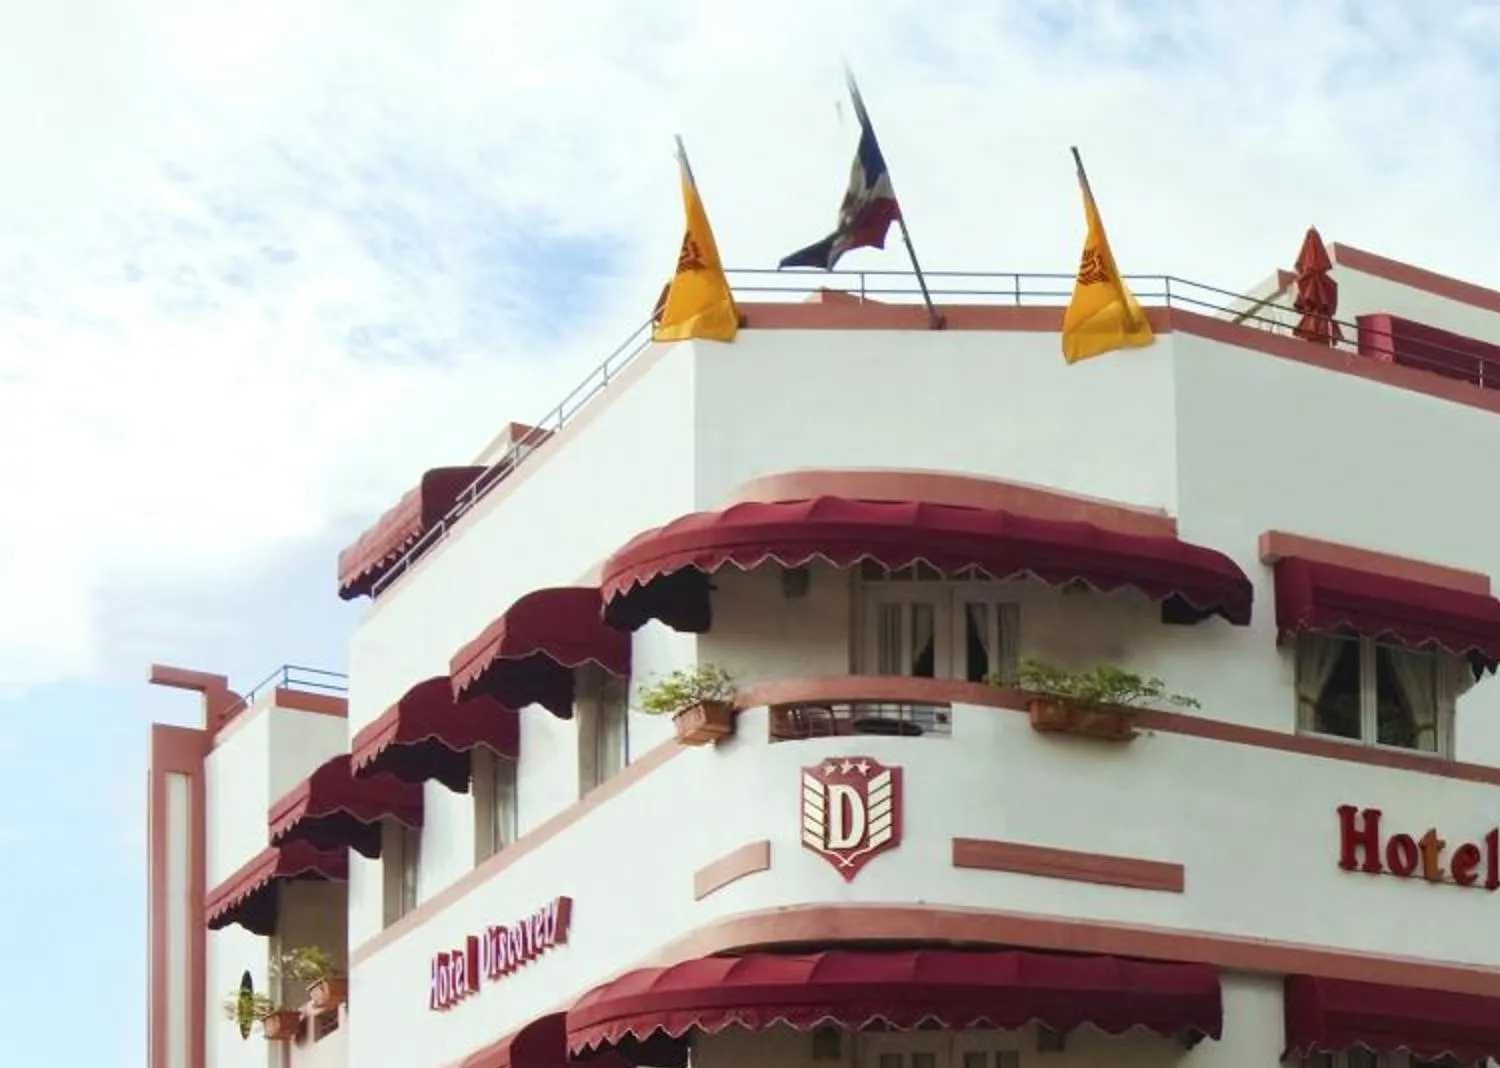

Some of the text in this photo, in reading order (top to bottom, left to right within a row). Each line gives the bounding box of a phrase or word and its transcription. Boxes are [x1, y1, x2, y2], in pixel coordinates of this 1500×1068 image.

[827, 783, 867, 849] D
[429, 895, 573, 1011] Hotel Discovery
